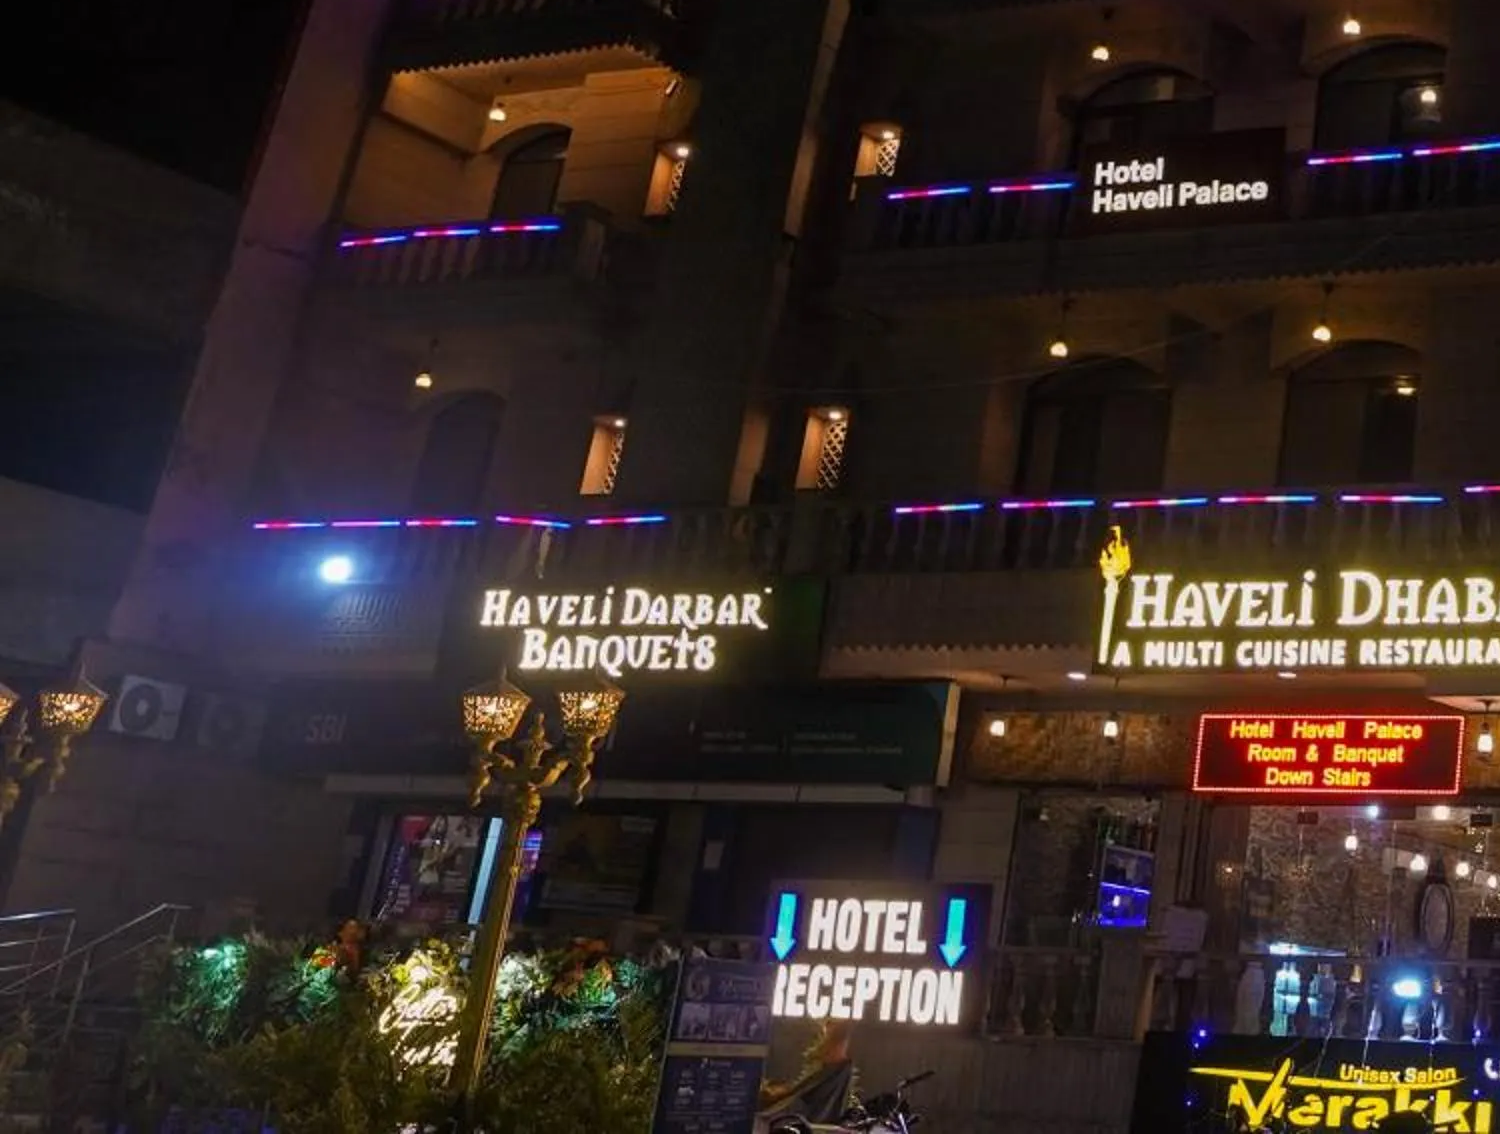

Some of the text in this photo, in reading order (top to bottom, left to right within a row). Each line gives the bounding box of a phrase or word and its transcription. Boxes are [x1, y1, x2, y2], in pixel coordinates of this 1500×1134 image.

[1094, 156, 1165, 186] Hotel
[1091, 179, 1269, 214] Haveli Palace
[621, 588, 769, 630] DARBAR
[1111, 641, 1132, 667] A
[1144, 640, 1224, 667] MULTI
[1236, 639, 1348, 666] CUISINE
[303, 712, 348, 744] SBI
[1230, 720, 1424, 740] Hotel Haveli Palace
[1247, 742, 1405, 767] Room & Banquet
[1265, 767, 1372, 787] Down Stairs
[807, 897, 928, 954] HOTEL
[1339, 1063, 1457, 1084] Unisex Salon
